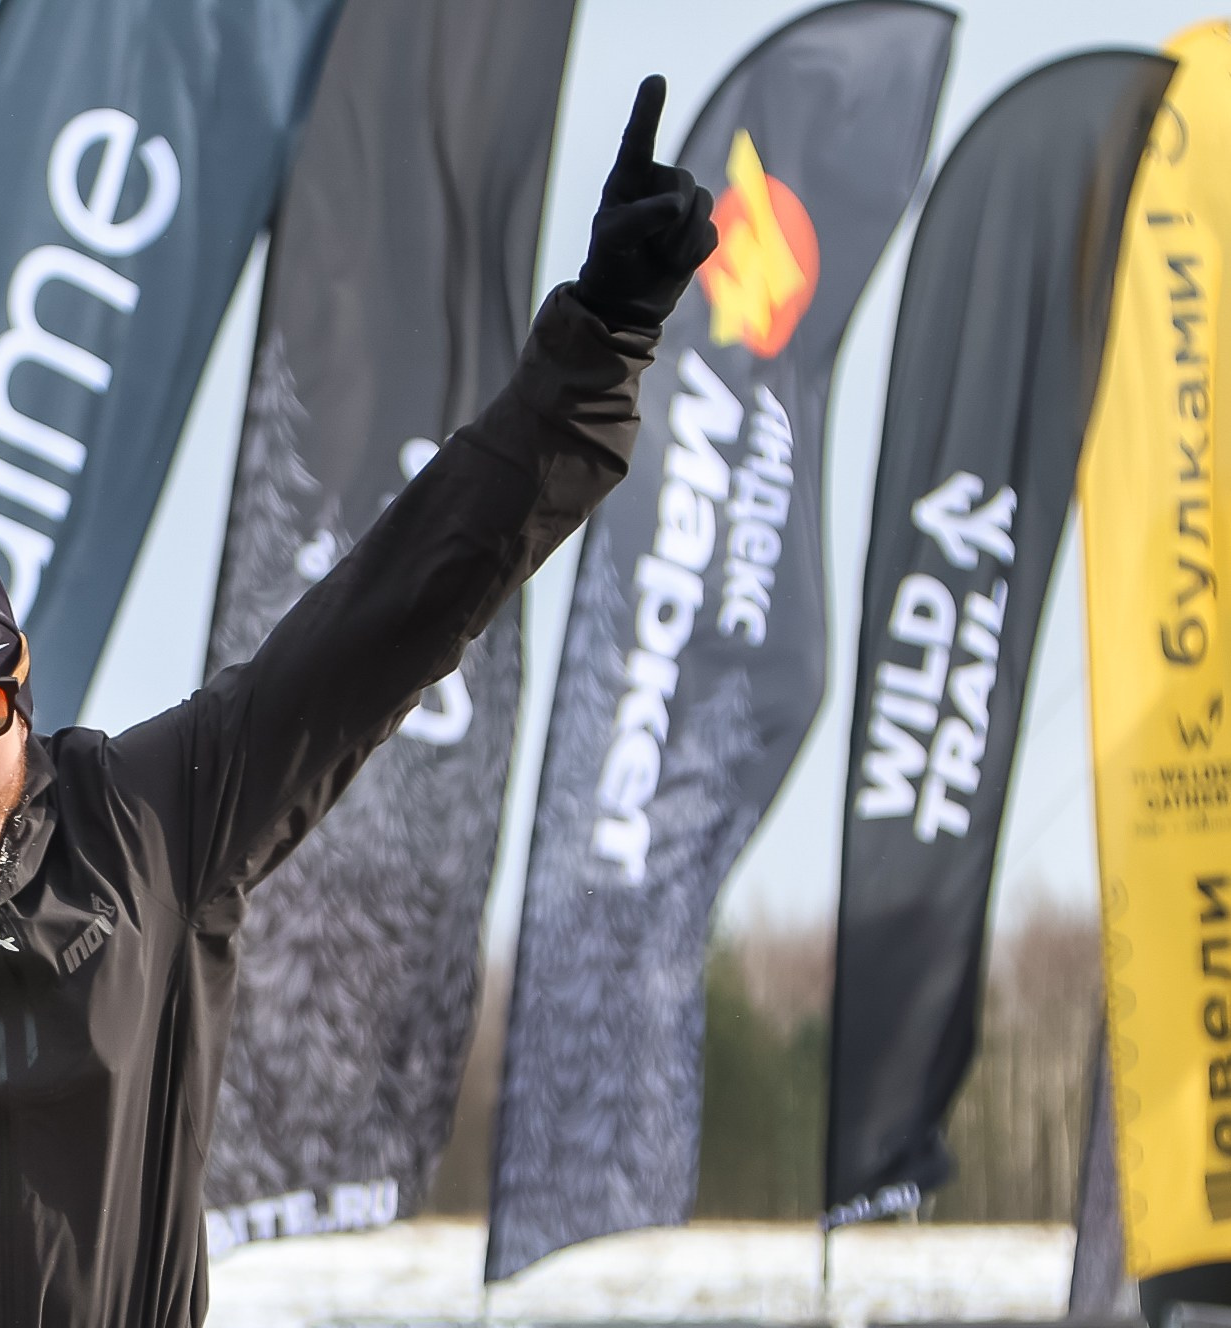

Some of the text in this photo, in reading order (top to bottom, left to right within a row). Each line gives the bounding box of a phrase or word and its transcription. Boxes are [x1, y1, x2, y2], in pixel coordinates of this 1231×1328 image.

[590, 346, 746, 887] Маркет
[856, 572, 957, 820] WILD
[914, 578, 1009, 845] TRAIL
